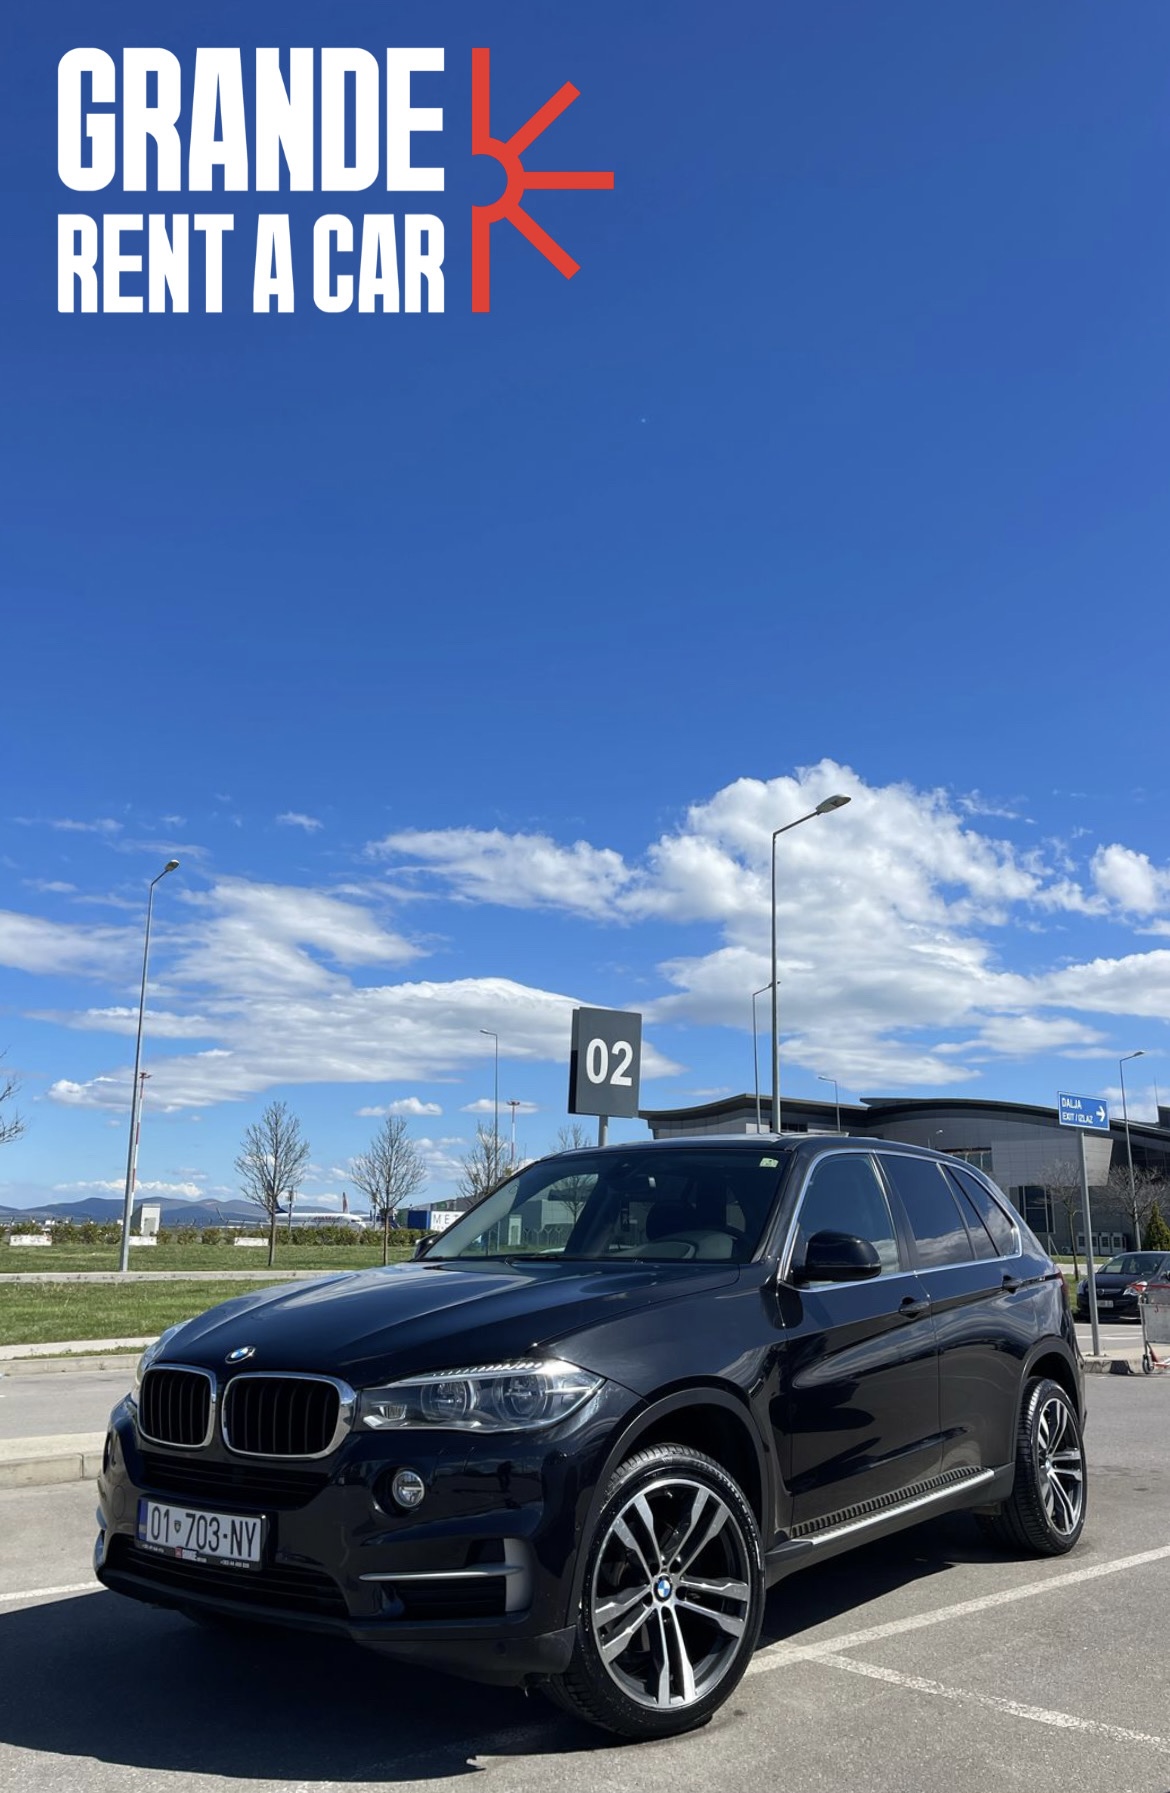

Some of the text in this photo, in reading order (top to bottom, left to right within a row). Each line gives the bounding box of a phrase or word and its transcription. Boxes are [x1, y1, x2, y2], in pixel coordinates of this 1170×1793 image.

[586, 1038, 634, 1087] 02
[1061, 1097, 1082, 1110] DALJA
[1062, 1111, 1074, 1121] EXIT
[151, 1505, 171, 1543] 01
[184, 1512, 257, 1558] 703-NY
